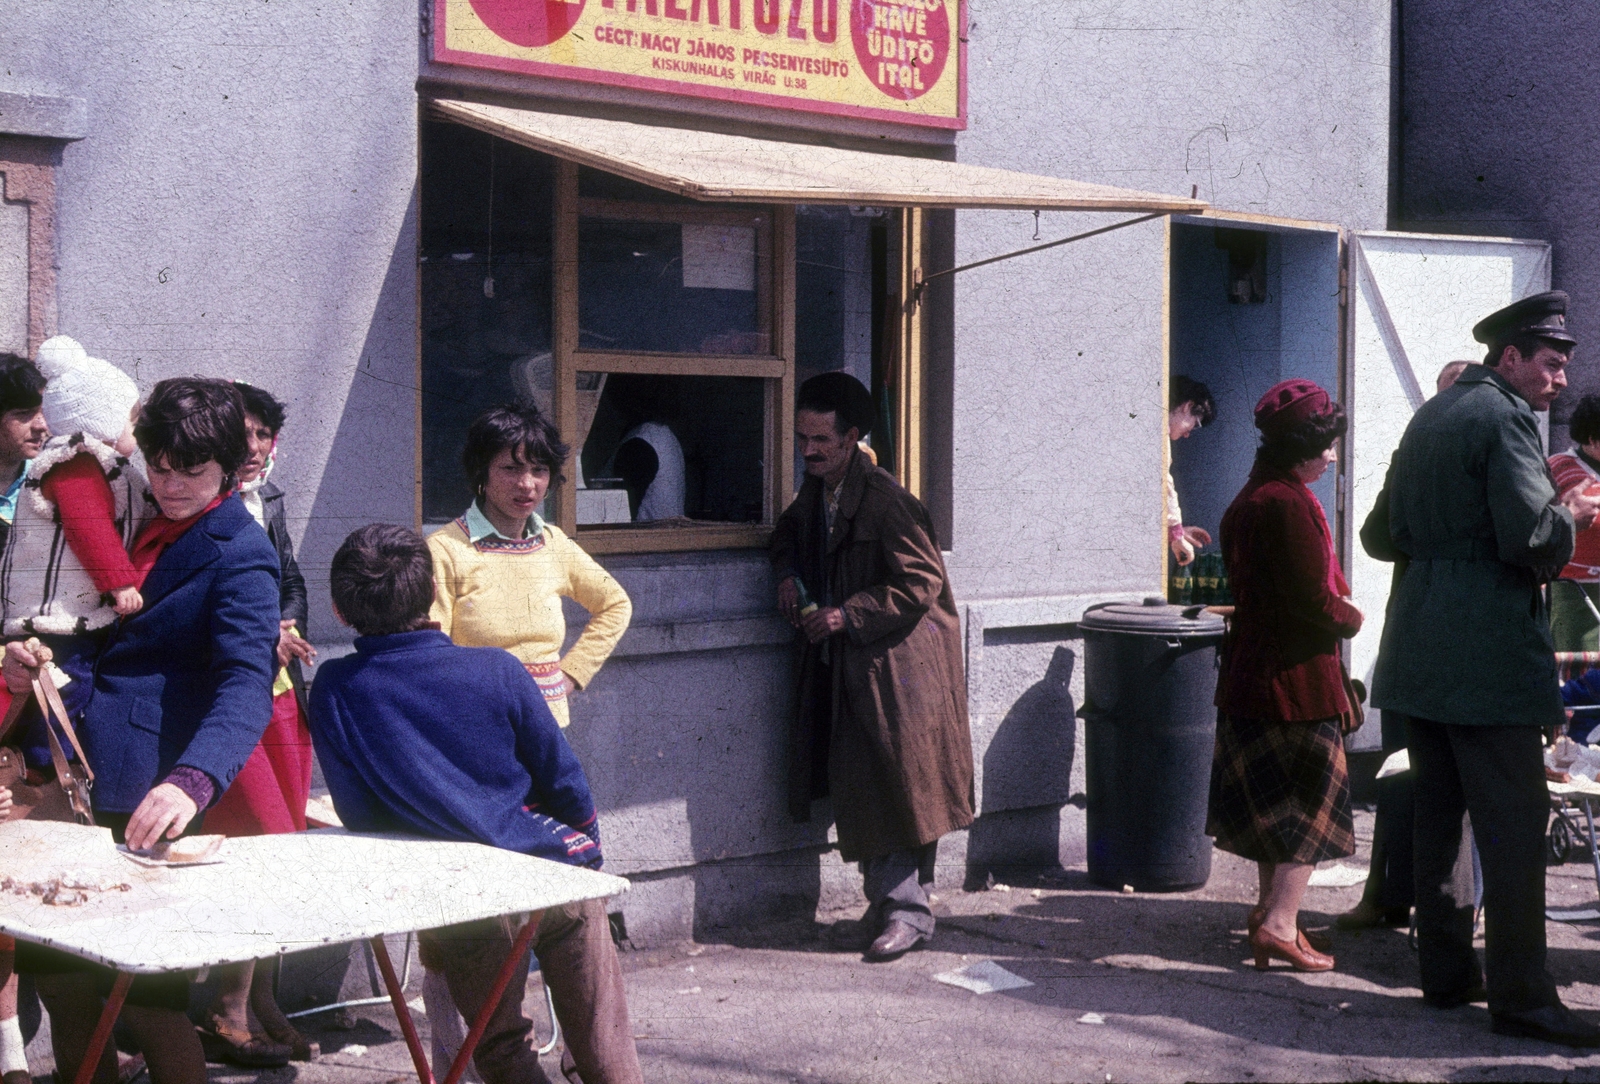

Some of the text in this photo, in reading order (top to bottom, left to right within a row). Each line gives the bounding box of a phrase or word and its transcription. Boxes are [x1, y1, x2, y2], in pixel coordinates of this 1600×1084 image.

[641, 31, 681, 54] NAGY
[687, 37, 735, 61] JÁNOS
[652, 56, 735, 80] KISKUNHALAS
[743, 69, 776, 85] VIRÁG
[878, 61, 924, 90] ITAL
